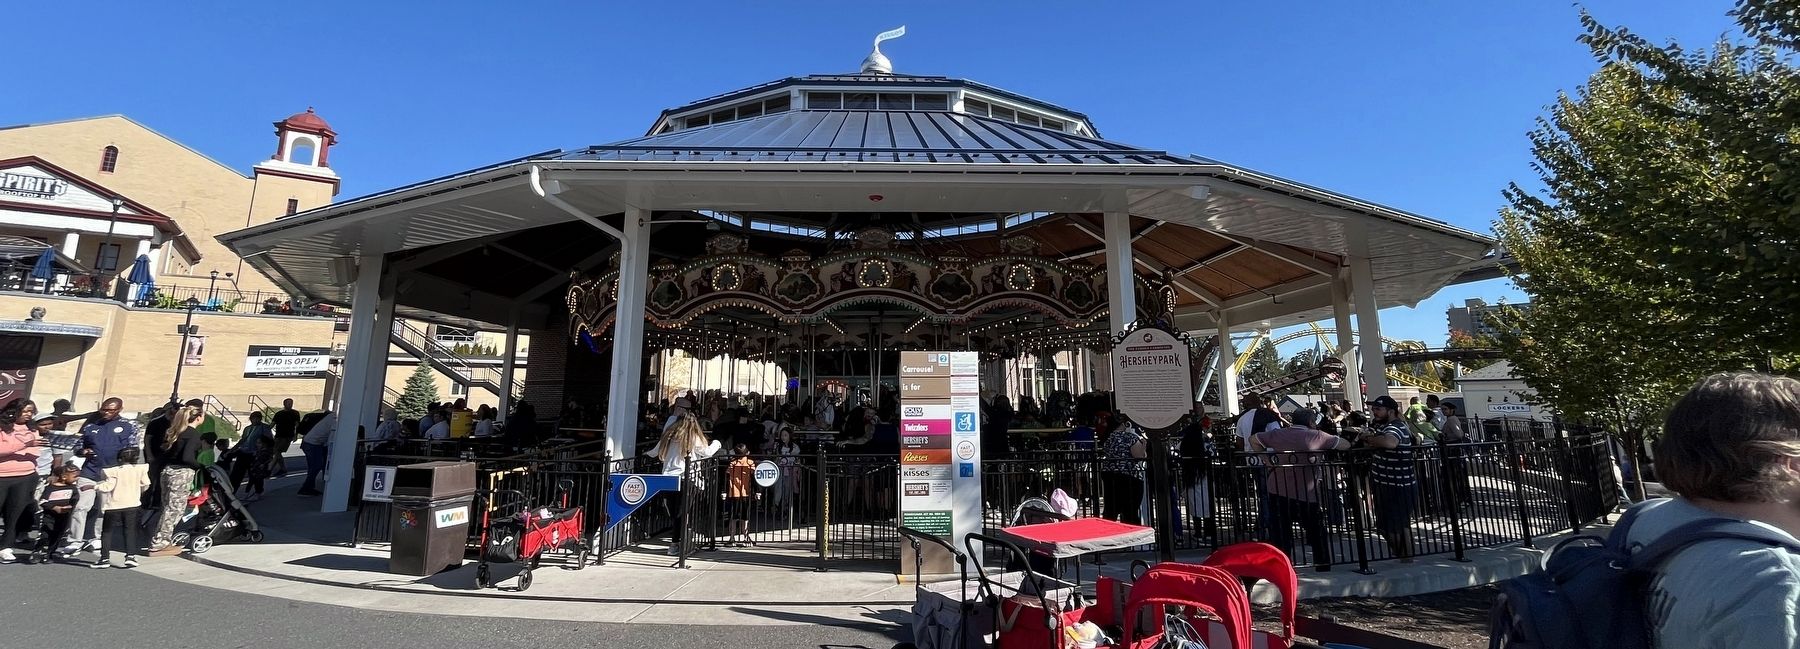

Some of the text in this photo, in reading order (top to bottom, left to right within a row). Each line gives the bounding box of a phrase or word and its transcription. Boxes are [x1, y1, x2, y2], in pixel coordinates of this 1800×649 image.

[256, 358, 283, 367] PATIO
[294, 357, 320, 365] OPEN
[1120, 353, 1182, 369] HERSHEYPARK
[902, 365, 934, 373] Carrousel
[902, 382, 921, 391] is for
[756, 469, 777, 479] ENTER
[441, 511, 465, 523] WM
